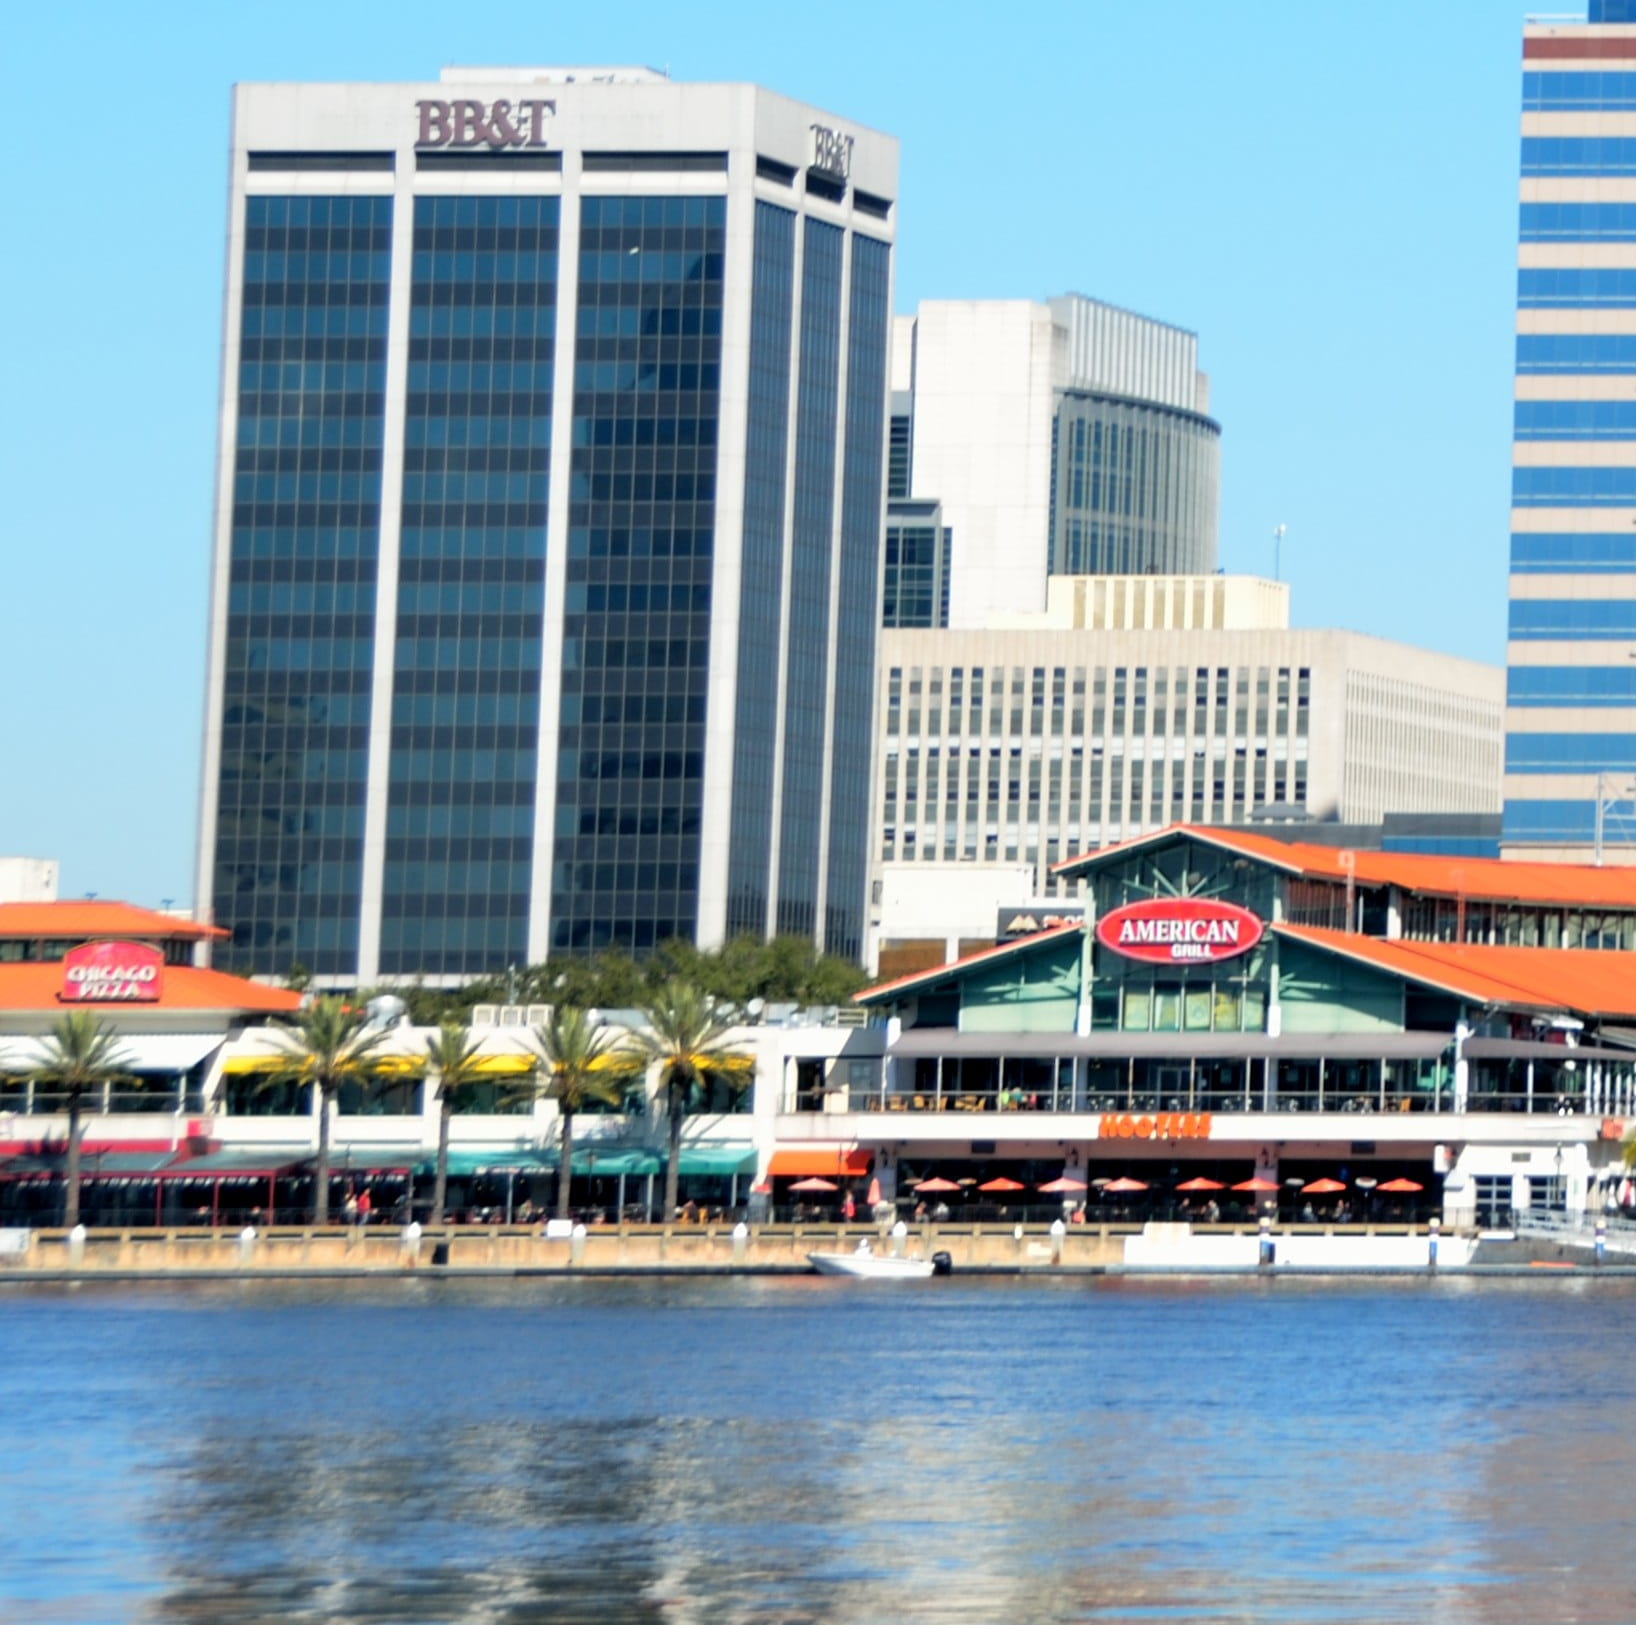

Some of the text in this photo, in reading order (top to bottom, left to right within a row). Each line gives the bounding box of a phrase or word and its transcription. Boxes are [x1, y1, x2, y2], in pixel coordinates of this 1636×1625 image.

[414, 99, 557, 148] BB&T
[1118, 919, 1240, 944] AMERICAN
[1170, 943, 1213, 958] GRILL
[67, 965, 157, 983] CHICAGO
